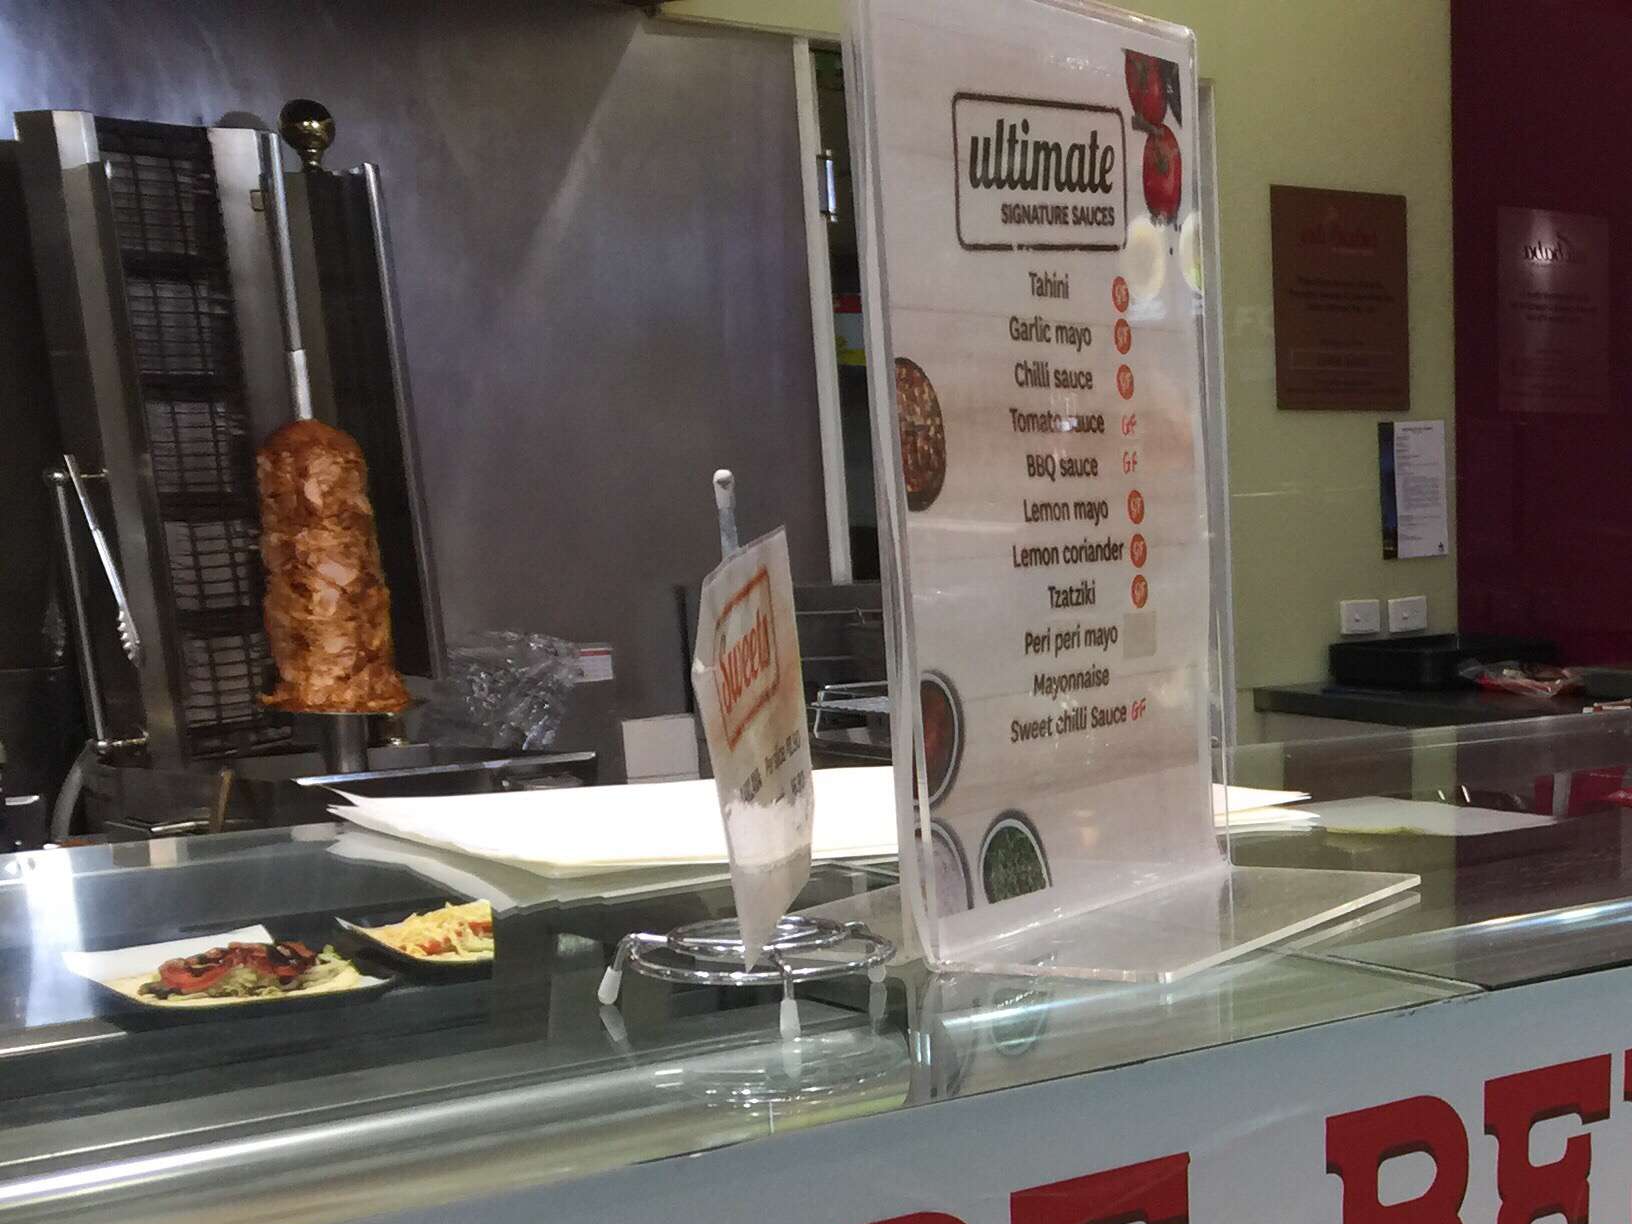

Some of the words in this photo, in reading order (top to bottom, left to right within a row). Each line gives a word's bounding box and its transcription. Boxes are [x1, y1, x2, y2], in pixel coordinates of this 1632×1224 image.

[969, 118, 1116, 194] ultimate
[1001, 202, 1069, 226] SIGNATURE
[1072, 205, 1115, 227] SAUCES
[1028, 272, 1070, 300] Tahini
[1009, 316, 1051, 344] Garlic
[1055, 324, 1092, 352] mayo
[1014, 361, 1050, 388] Chilli
[1054, 367, 1093, 391] sauce
[1067, 413, 1105, 434] auce
[1026, 454, 1056, 483] BBQ
[1060, 457, 1098, 478] sauce
[1023, 498, 1070, 522] Lemon
[1073, 500, 1109, 527] mayo
[1012, 545, 1059, 568] Lemon
[1063, 537, 1124, 564] coriander
[1048, 580, 1096, 609] Tzatziki
[1025, 628, 1050, 656] Peri
[1054, 625, 1081, 658] peri
[1084, 624, 1118, 654] mayo
[1033, 665, 1110, 700] Mayonnaise
[1010, 716, 1053, 744] Sweet
[1056, 710, 1087, 735] chilli
[1090, 703, 1127, 728] Sauce
